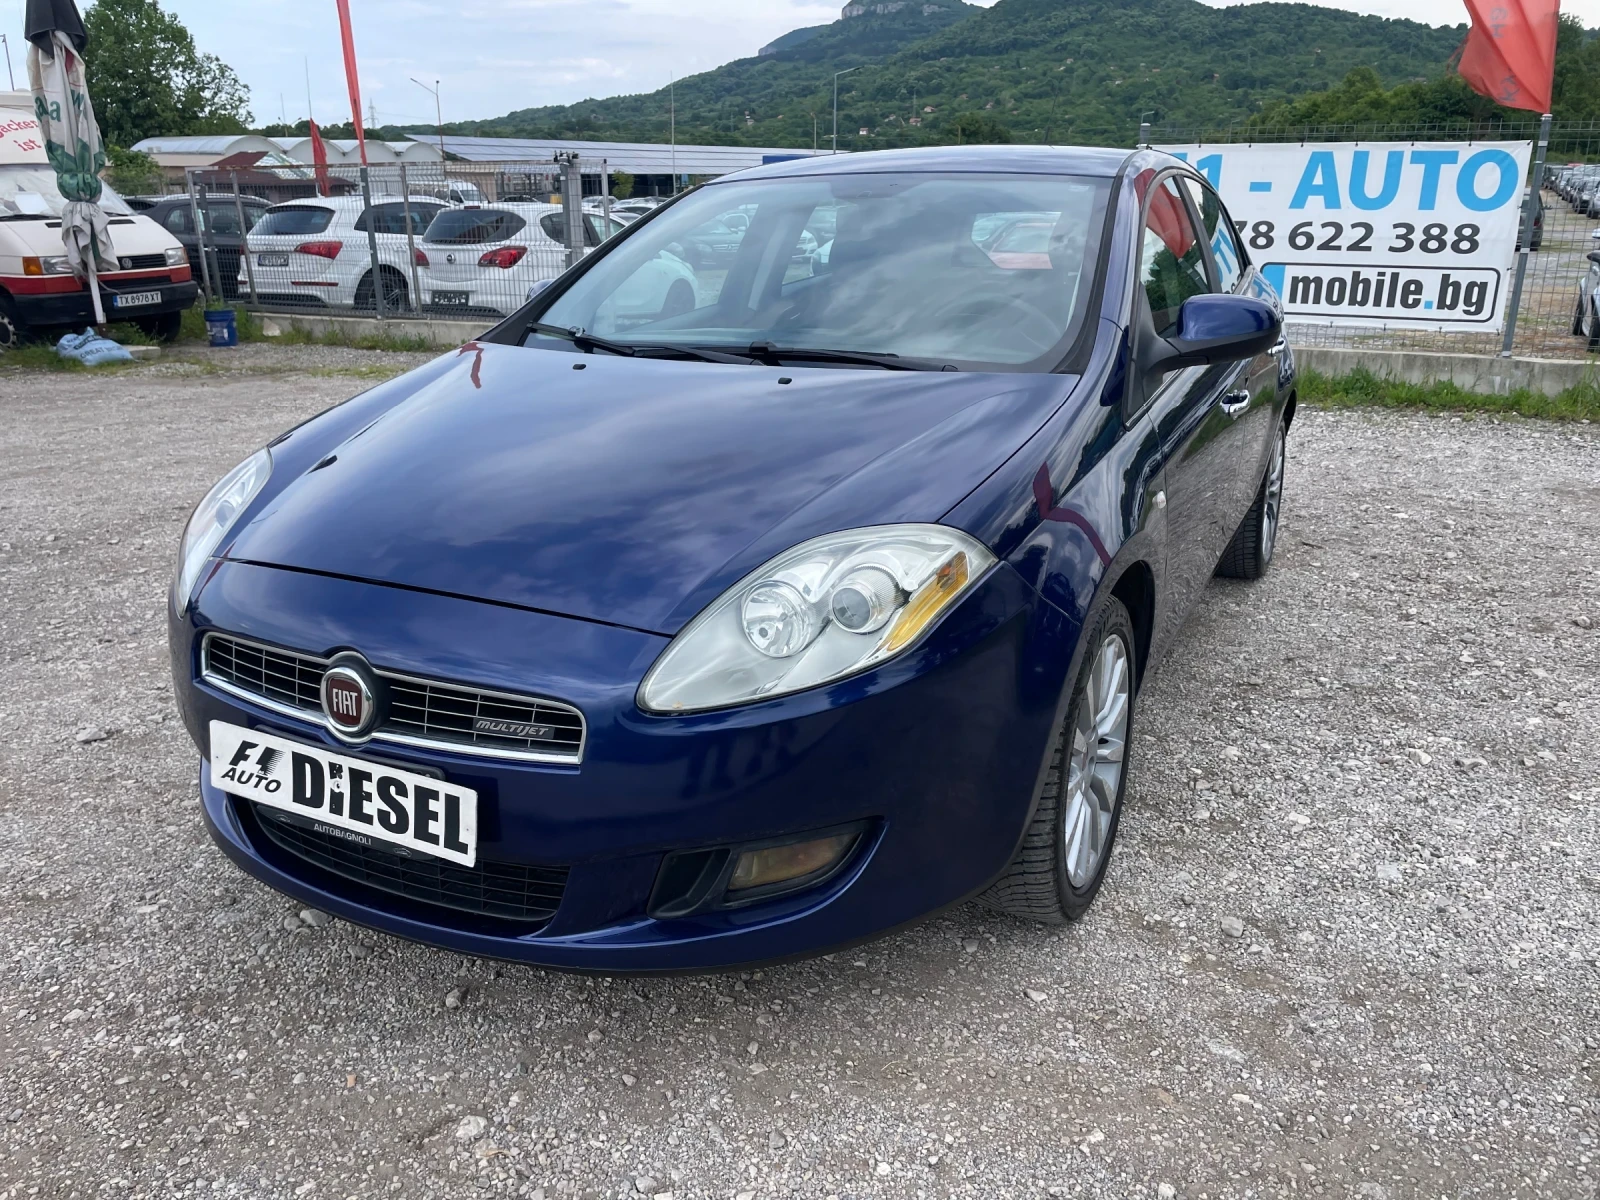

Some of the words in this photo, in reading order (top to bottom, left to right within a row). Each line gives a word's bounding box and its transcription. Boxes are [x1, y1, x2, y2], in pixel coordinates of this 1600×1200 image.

[13, 138, 42, 152] ist
[1288, 149, 1519, 212] AUTO
[1288, 221, 1374, 252] 622
[1387, 222, 1480, 255] 388
[1288, 270, 1489, 316] mobile.bg
[332, 688, 358, 716] FIAT
[220, 766, 282, 793] AUTO
[291, 750, 469, 856] DIESEL
[314, 823, 372, 846] AUTOBAGNOLI
